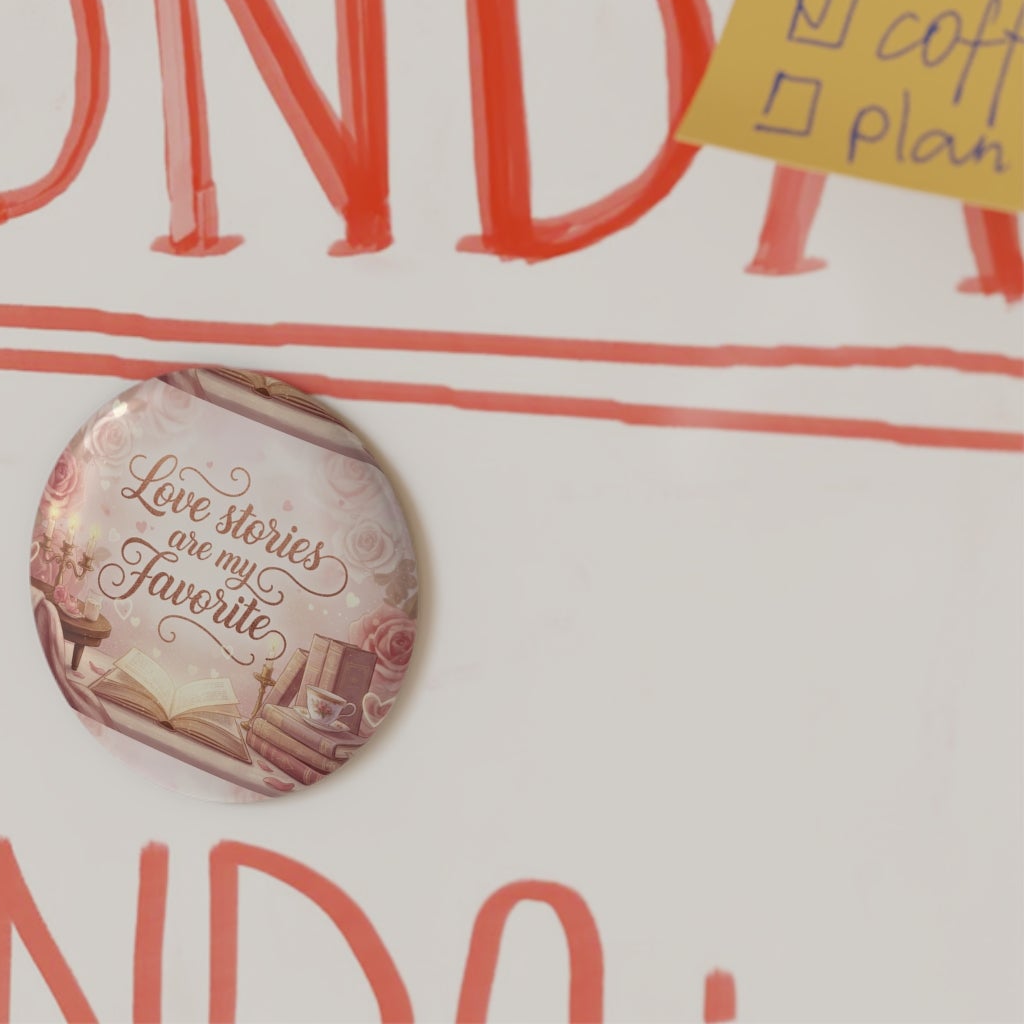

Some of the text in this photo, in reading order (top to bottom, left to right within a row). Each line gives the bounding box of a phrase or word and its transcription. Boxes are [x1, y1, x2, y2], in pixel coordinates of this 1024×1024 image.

[846, 88, 1007, 174] plan
[121, 454, 348, 586] Love stories
[168, 529, 274, 597] are my
[98, 536, 286, 659] Favorite
